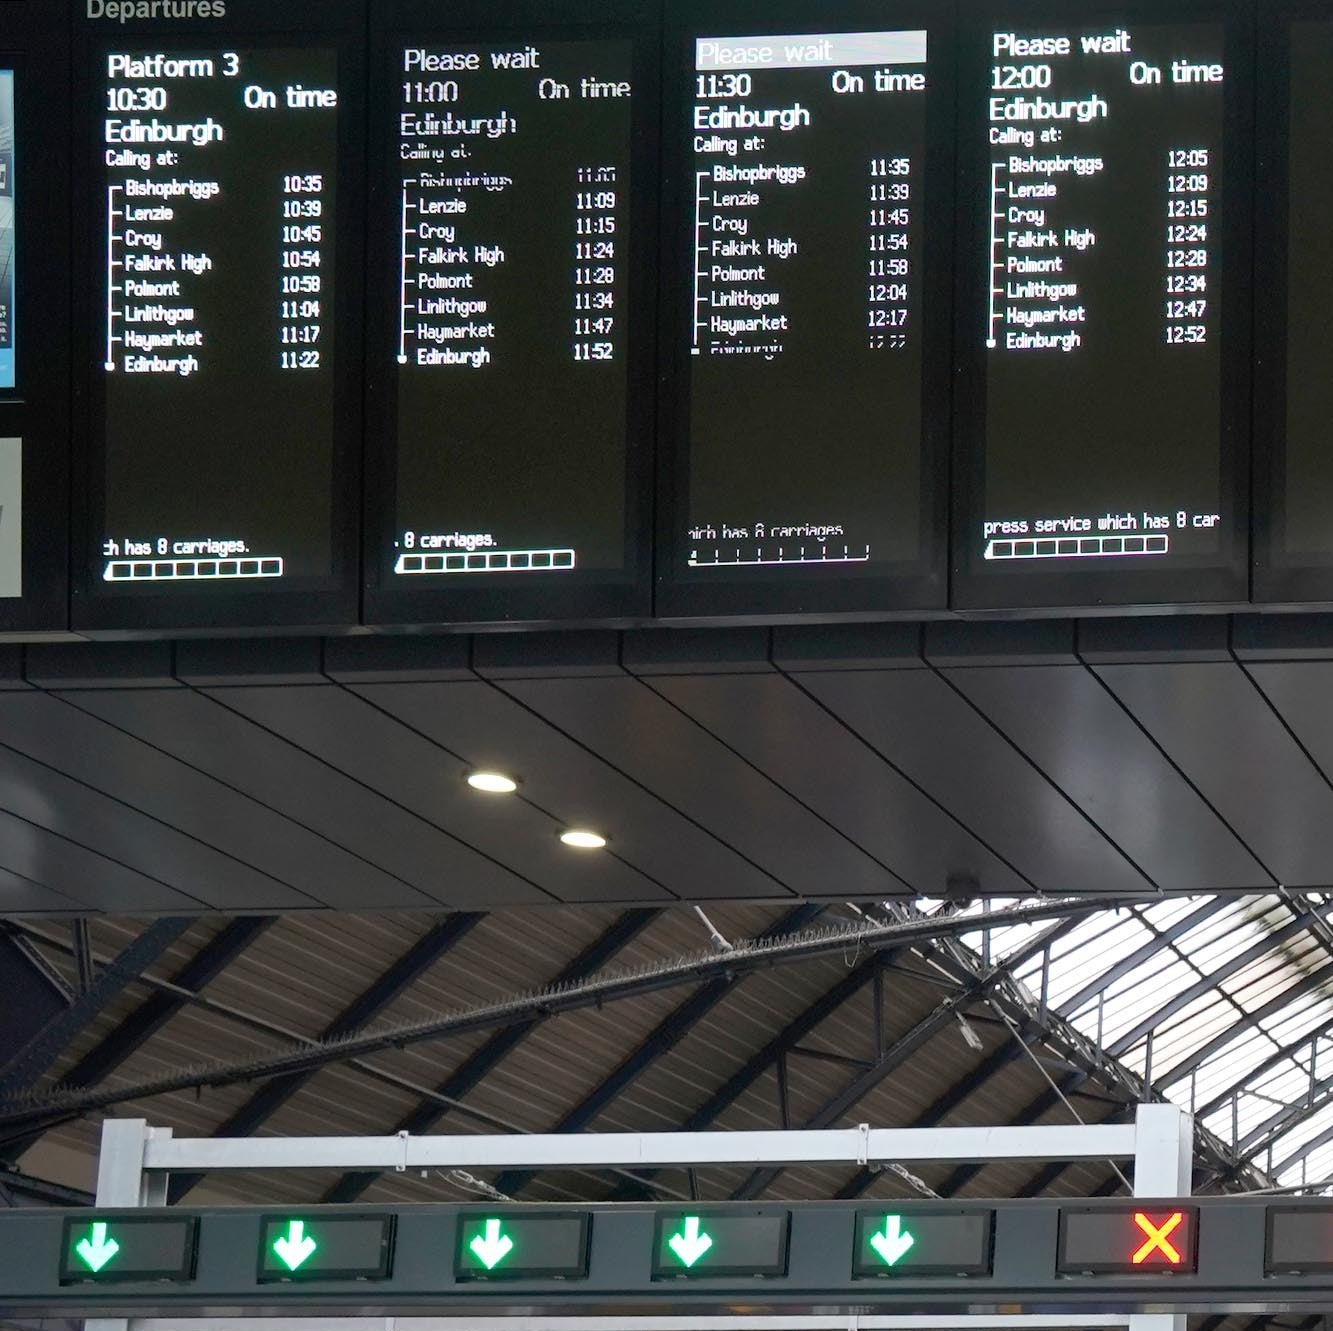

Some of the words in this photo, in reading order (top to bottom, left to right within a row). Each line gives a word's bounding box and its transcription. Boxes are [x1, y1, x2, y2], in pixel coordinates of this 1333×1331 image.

[87, 0, 226, 23] Departures
[993, 32, 1071, 57] Please
[1080, 28, 1132, 54] wait
[108, 53, 214, 79] Platform
[222, 52, 240, 77] 3
[991, 64, 1052, 90] 12:00
[1129, 61, 1161, 85] On
[1171, 59, 1224, 84] time
[106, 87, 167, 112] 10:30
[244, 85, 277, 109] On
[285, 84, 338, 108] time
[989, 94, 1108, 123] Edinburgh
[105, 117, 224, 147] Edinburgh
[105, 149, 151, 171] Calling
[155, 149, 178, 166] at:
[125, 178, 220, 201] Bishopbriggs
[283, 174, 323, 193] 10:35
[125, 204, 174, 222] Lenzie
[283, 199, 322, 218] 10:39
[125, 229, 162, 251] Croy
[282, 225, 322, 243] 10:45
[125, 253, 176, 272] Falkirk
[181, 253, 212, 275] High
[282, 250, 321, 268] 10:54
[124, 279, 180, 297] Polmont
[282, 275, 321, 294] 10:58
[124, 304, 195, 326] Linlithgow
[282, 300, 321, 319] 11:04
[124, 329, 203, 352] Haymarket
[281, 325, 321, 344] 11:17
[124, 354, 199, 377] Edinburgh
[281, 350, 320, 369] 11:22
[124, 538, 152, 556] has
[157, 537, 168, 555] 8
[172, 538, 250, 558] carriages.
